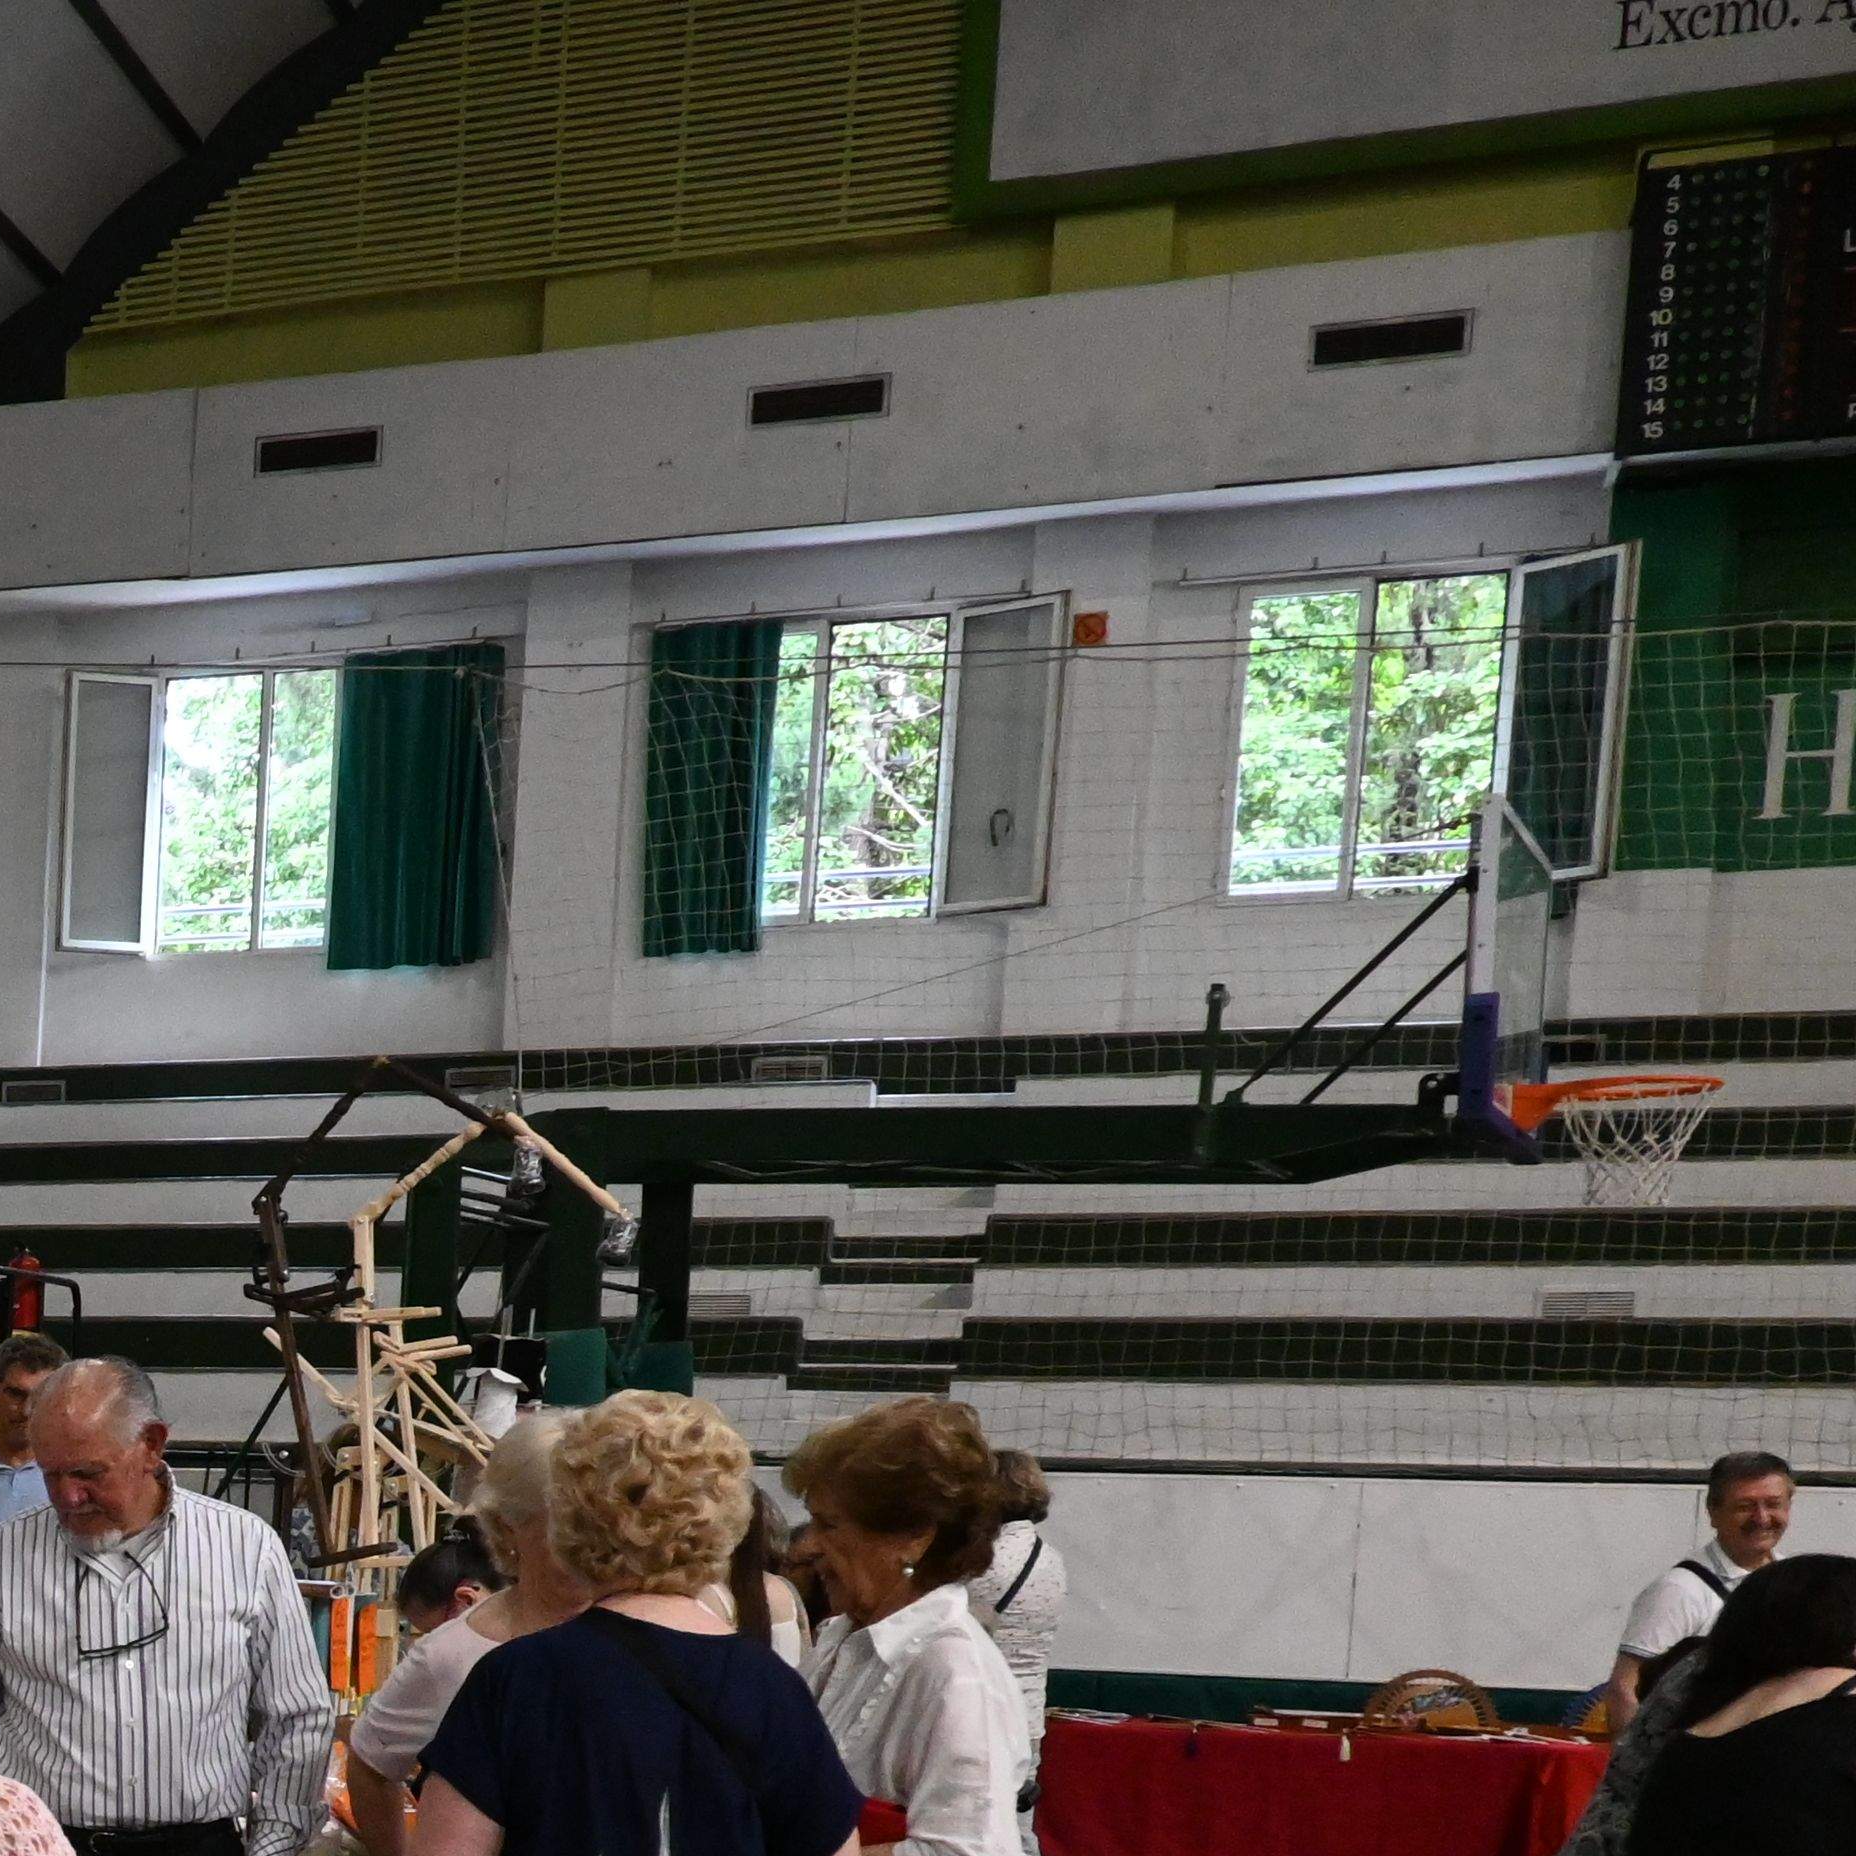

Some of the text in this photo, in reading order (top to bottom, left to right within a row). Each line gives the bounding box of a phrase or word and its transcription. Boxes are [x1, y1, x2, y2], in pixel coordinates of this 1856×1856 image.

[1612, 0, 1801, 50] Excmo.
[1666, 174, 1681, 191] 4
[1665, 196, 1681, 214] 5
[1663, 219, 1679, 237] 6
[1663, 241, 1677, 259] 7
[1660, 263, 1677, 282] 8
[1658, 286, 1674, 304] 9
[1649, 309, 1674, 327] 10
[1650, 331, 1669, 349] 11
[1647, 353, 1670, 371] 12
[1645, 376, 1668, 393] 13
[1644, 398, 1666, 416] 14
[1641, 420, 1664, 440] 15
